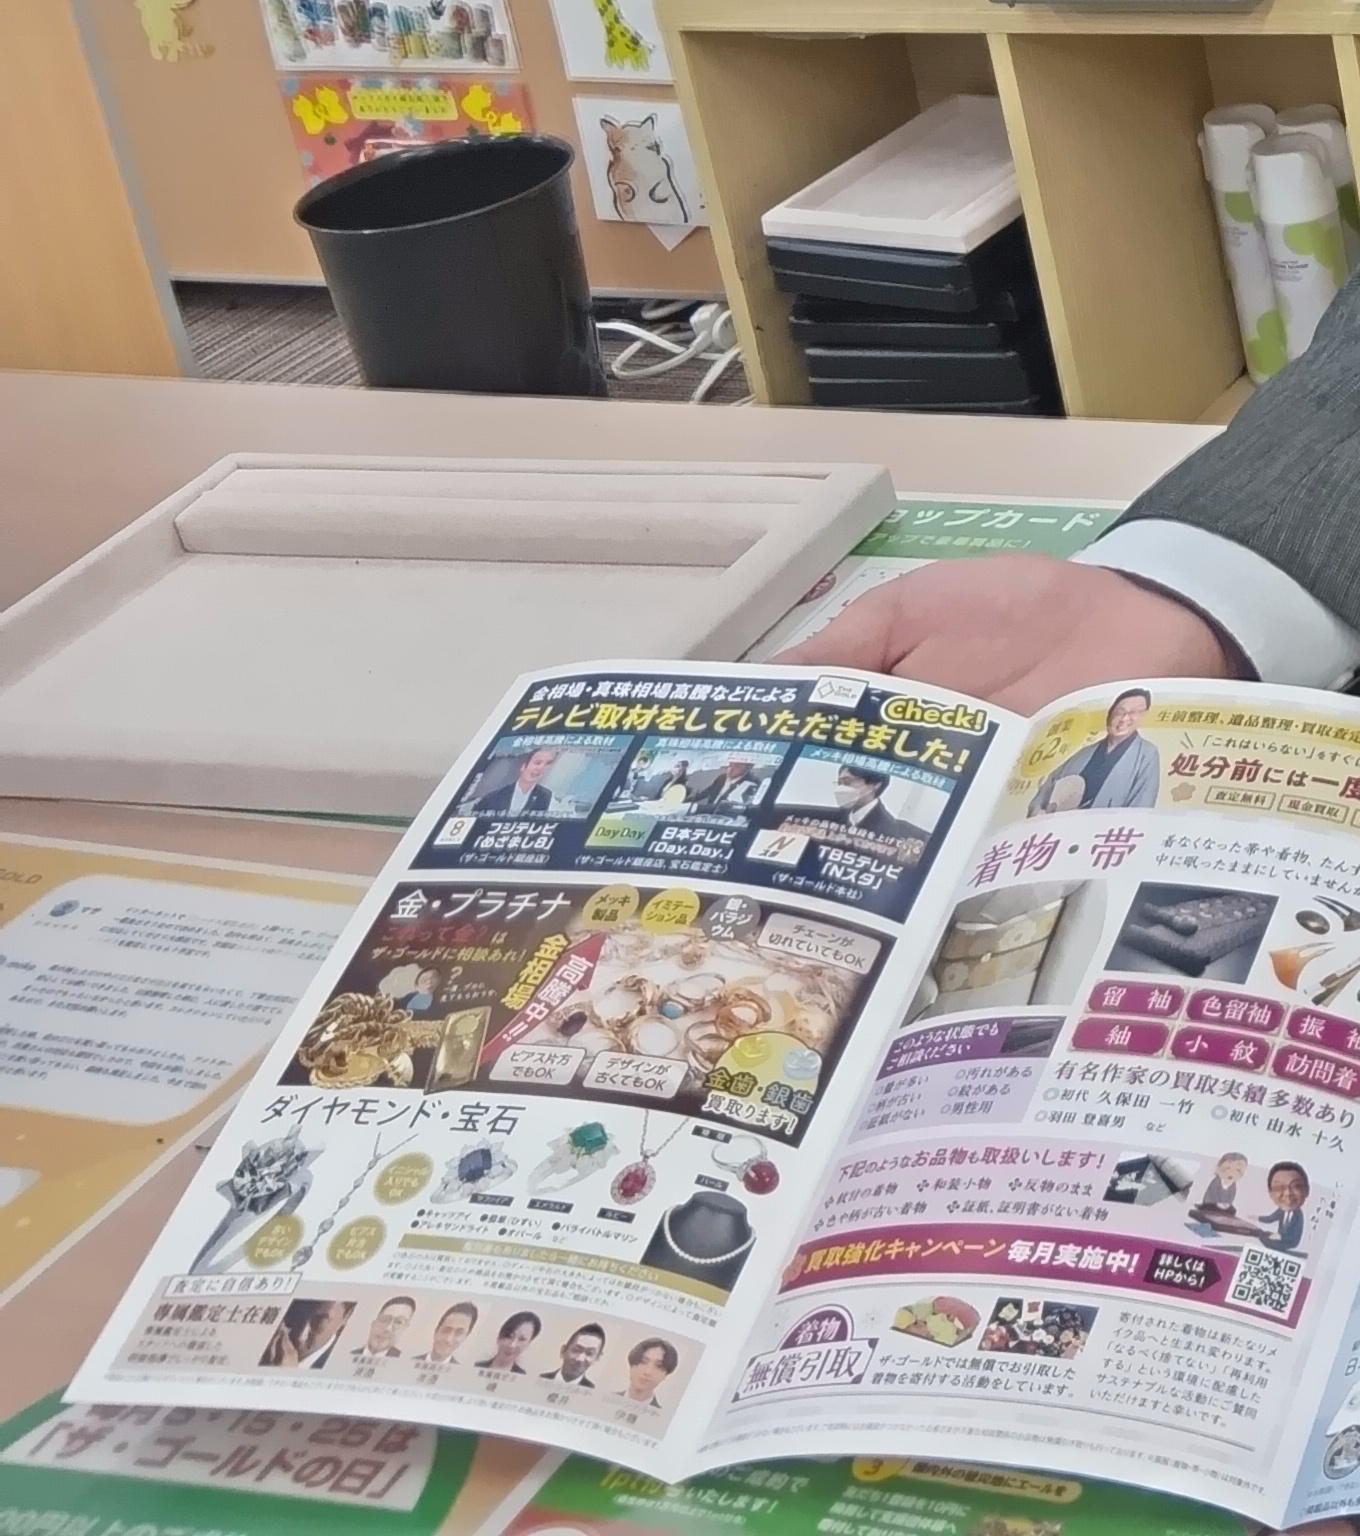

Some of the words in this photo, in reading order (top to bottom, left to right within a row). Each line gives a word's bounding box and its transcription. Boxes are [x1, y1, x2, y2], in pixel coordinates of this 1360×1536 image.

[511, 704, 971, 774] テレビ取材をしていただきました!
[487, 821, 560, 837] フジテレビ
[660, 826, 738, 845] 日本テレビ
[816, 843, 905, 881] TBSテレビ
[968, 826, 1147, 888] 着物・帯
[390, 888, 572, 921] 金・プラチナ
[767, 932, 867, 970] 切れていてもOK
[507, 1050, 572, 1068] ピアス片方
[510, 1063, 555, 1081] でもOK
[1284, 1051, 1360, 1090] 訪問着
[594, 1071, 666, 1093] 古くてもOK
[1054, 1059, 1357, 1131] 有名作家の買取実績多数あり
[260, 1094, 527, 1137] ダイヤモンド・宝石
